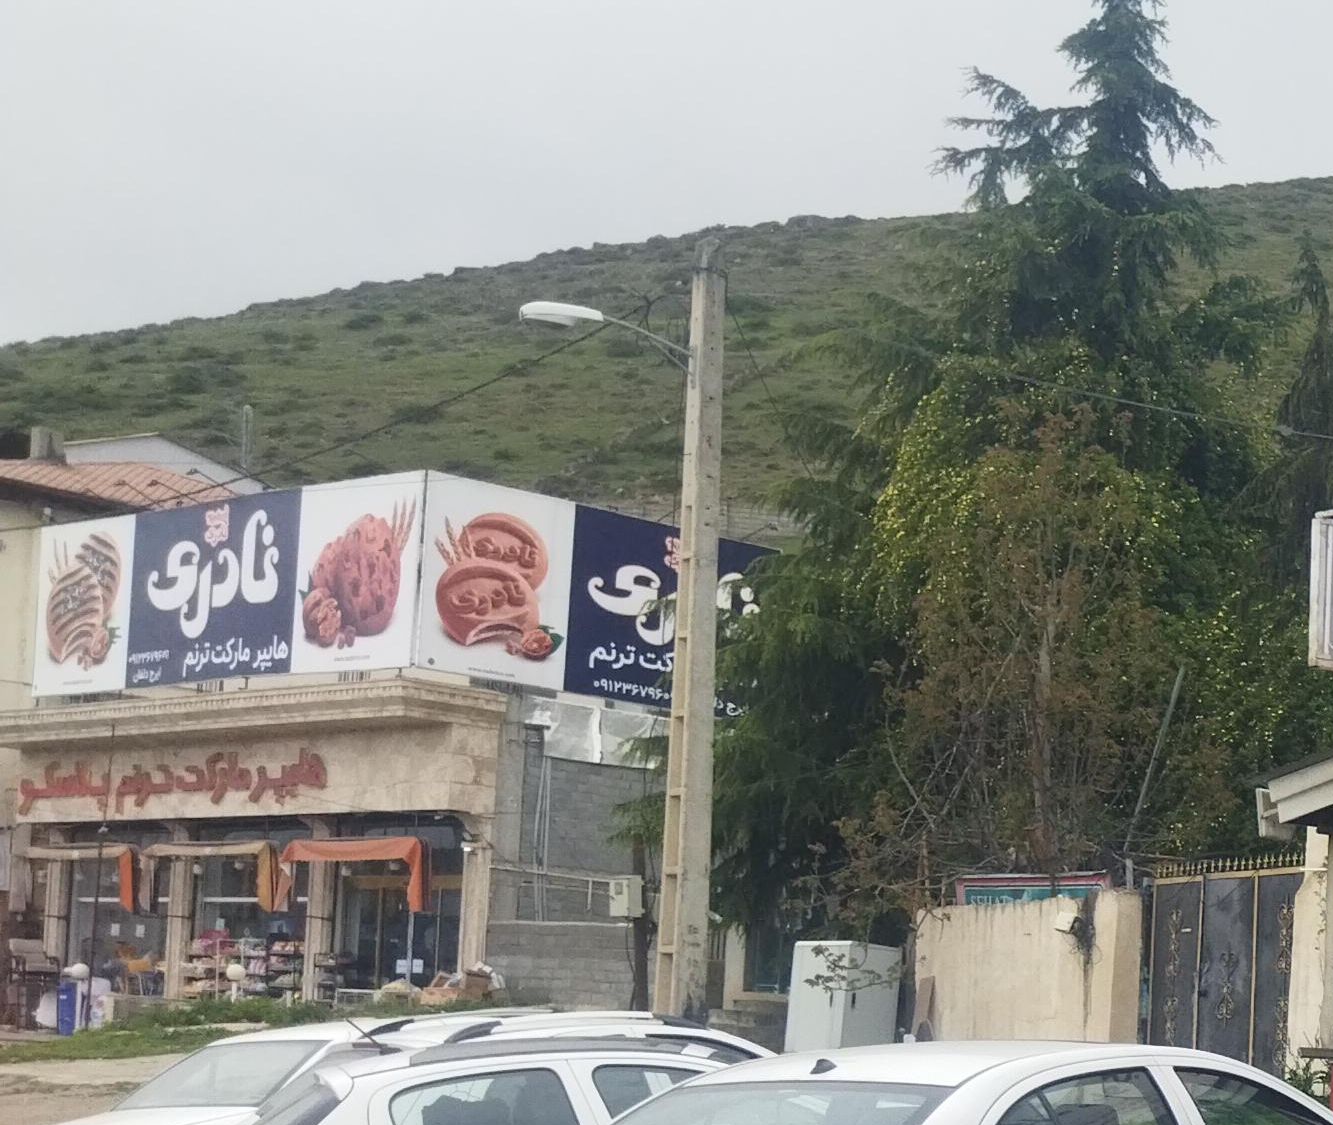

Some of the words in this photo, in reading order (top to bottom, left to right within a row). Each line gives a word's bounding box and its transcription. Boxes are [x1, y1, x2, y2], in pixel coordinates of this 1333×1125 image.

[147, 509, 279, 639] نادری
[182, 642, 210, 678] ترنم
[211, 637, 250, 671] مارکت
[253, 635, 289, 672] هایپر
[588, 642, 635, 668] ترنم
[594, 680, 673, 700] ۰۹۱۲۳۶۷۹۶۰
[175, 752, 250, 804] مارکت
